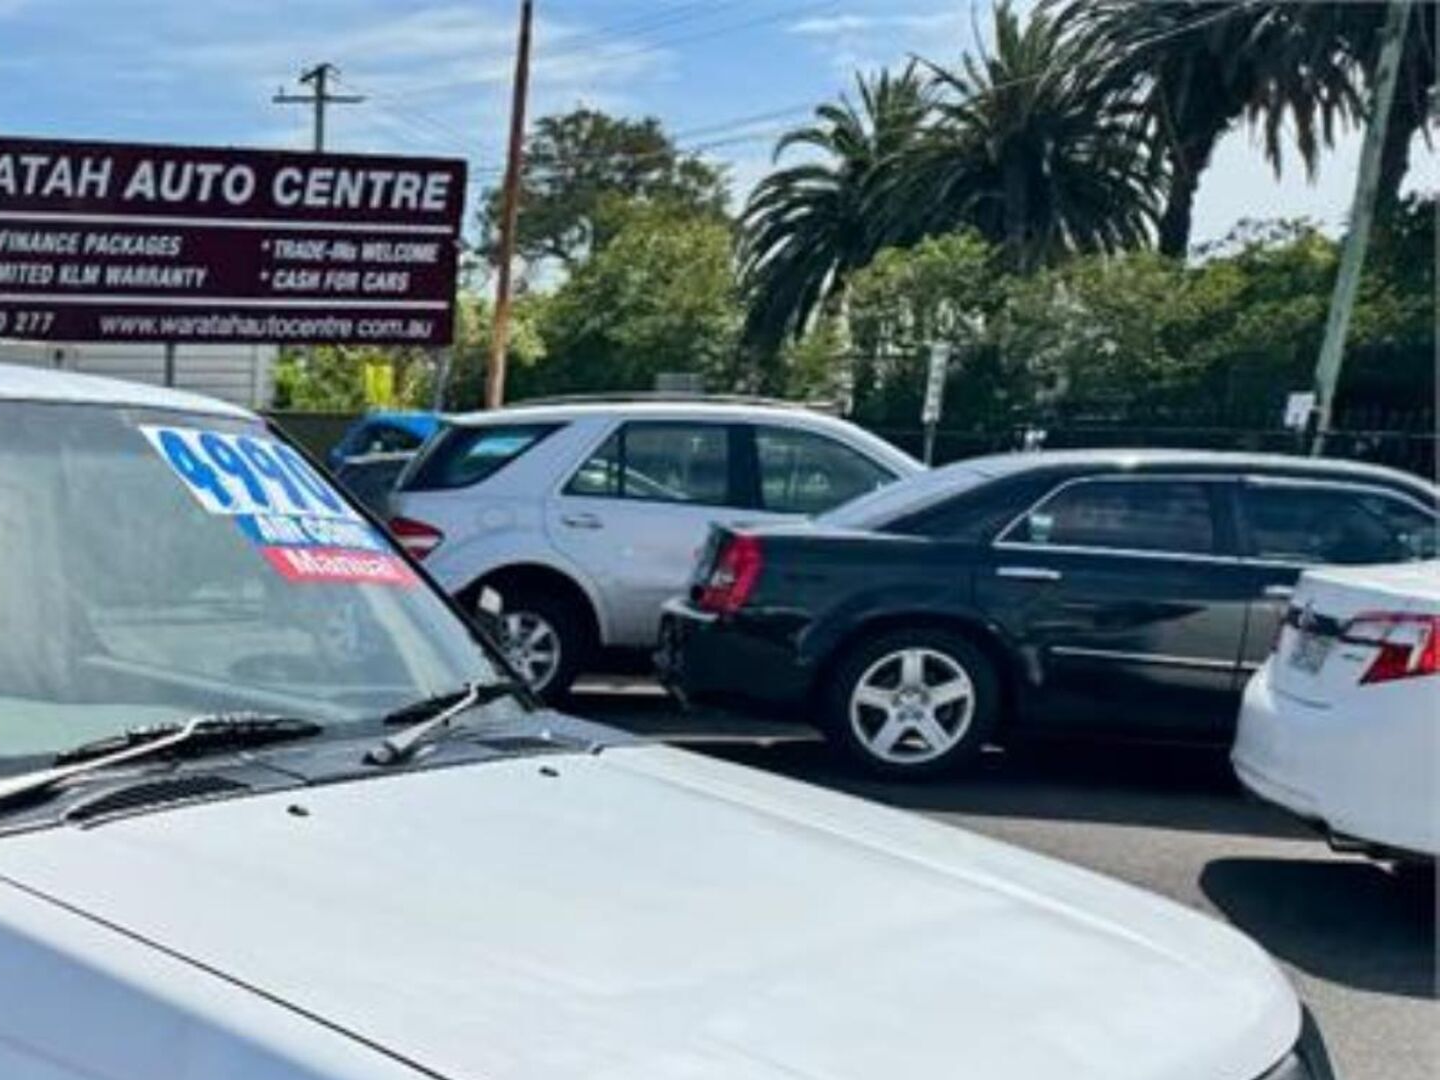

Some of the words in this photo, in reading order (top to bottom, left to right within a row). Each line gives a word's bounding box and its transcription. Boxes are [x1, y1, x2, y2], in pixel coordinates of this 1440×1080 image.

[124, 161, 256, 203] AUTO
[272, 167, 451, 210] CENTRE
[83, 233, 183, 256] PACKAGES
[361, 242, 440, 263] WELCOME
[58, 264, 101, 285] KLM
[105, 265, 206, 288] WARRANTY
[272, 269, 320, 290] CASH
[323, 270, 359, 291] FOR
[362, 271, 410, 292] CARS
[13, 311, 56, 333] 277
[100, 314, 433, 338] www.waratahautocentrecom.au
